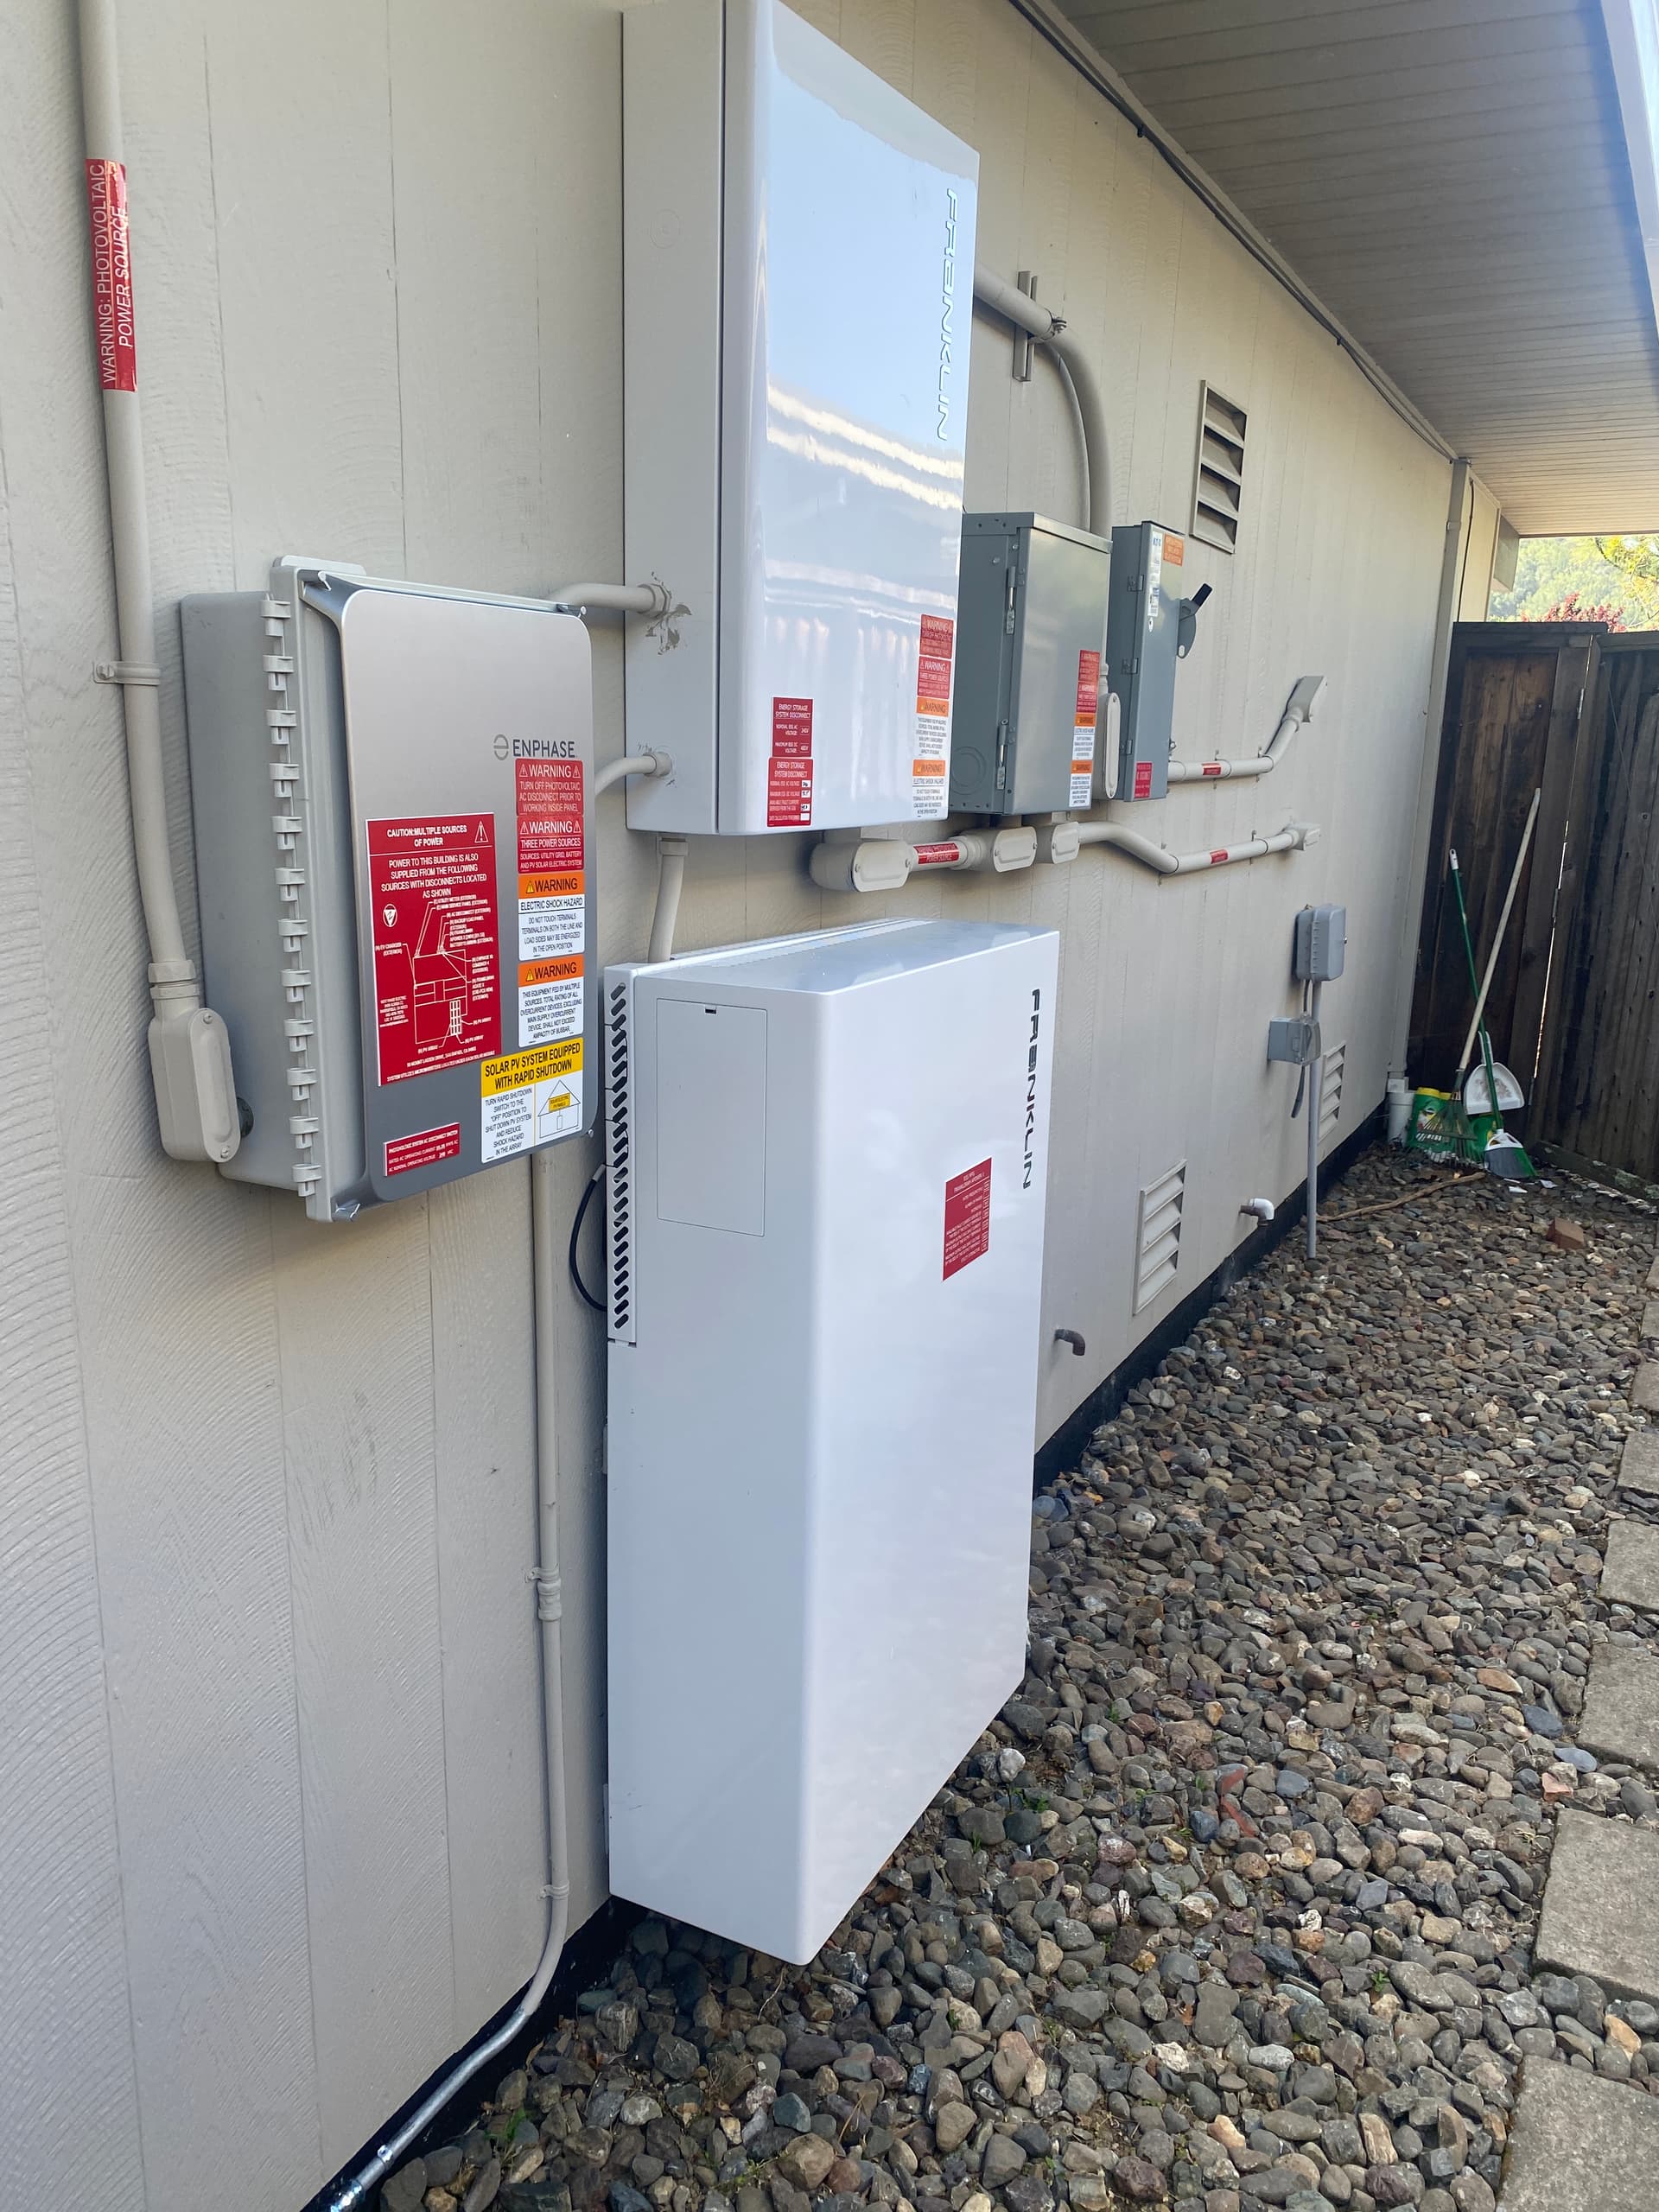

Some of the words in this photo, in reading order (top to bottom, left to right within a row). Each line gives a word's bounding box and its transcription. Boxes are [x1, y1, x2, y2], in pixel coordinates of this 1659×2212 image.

[89, 164, 111, 294] PHOTOVOLTAIC
[111, 205, 128, 278] SOURCE
[115, 283, 133, 347] POWER
[937, 188, 958, 442] FRANKLIN
[98, 299, 116, 383] WARNING:
[925, 661, 945, 671] WARNING
[925, 702, 945, 713] WARNING
[513, 739, 576, 759] ENPHASE
[529, 764, 571, 778] WARNING
[922, 762, 942, 772] WARNING
[519, 781, 534, 790] TURN
[442, 825, 467, 834] SOURCES
[530, 821, 572, 834] WARNING
[423, 837, 443, 846] POWER
[521, 840, 537, 849] THREE
[539, 839, 556, 848] POWER
[557, 838, 581, 847] SOURCES
[389, 859, 410, 868] POWER
[412, 858, 419, 867] TO
[421, 857, 432, 866] THIS
[434, 855, 457, 864] BUILDING
[465, 853, 478, 861] ALSO
[391, 869, 418, 880] SUPPLIED
[419, 868, 435, 877] FROM
[436, 867, 446, 875] THE
[448, 864, 478, 874] FOLLOWING
[381, 881, 409, 892] SOURCES
[410, 880, 424, 889] WITH
[426, 876, 462, 887] DISCONNECTS
[463, 874, 486, 883] LOCATED
[535, 878, 577, 892] WARNING
[423, 890, 429, 899] AS
[431, 888, 451, 898] SHOWN
[521, 900, 544, 911] ELECTRIC
[546, 899, 563, 909] SHOCK
[564, 897, 582, 907] HAZARD
[557, 913, 575, 922] TERMINALS
[522, 925, 543, 935] TERMINALS
[561, 931, 580, 940] ENERGIZED
[535, 962, 576, 979] WARNING
[531, 987, 551, 996] EQUIPMENT
[564, 982, 580, 992] MULTIPLE
[520, 1005, 546, 1016] OVERCURRENT
[563, 999, 582, 1009] EXCLUDING
[527, 1014, 536, 1023] MAIN
[537, 1013, 550, 1021] SUPPLY
[551, 1008, 575, 1019] OVERCURRENT
[543, 1020, 553, 1029] SHALL
[562, 1017, 575, 1026] EXCEED
[533, 1029, 550, 1039] AMPACITY
[486, 1060, 509, 1077] SOLAR
[512, 1058, 520, 1071] PV
[522, 1051, 548, 1068] SYSTEM
[550, 1042, 580, 1061] EQUIPPED
[495, 1074, 512, 1090] WITH
[515, 1069, 534, 1084] RAPID
[537, 1058, 572, 1079] SHUTDOWN
[1022, 988, 1040, 1191] FRANKLIN
[486, 1097, 497, 1106] TURN
[498, 1094, 509, 1103] RAPID
[510, 1088, 532, 1099] SHUTDOWN
[493, 1103, 509, 1113] SWITCH
[502, 1109, 521, 1119] POSITION
[486, 1123, 497, 1133] SHUT
[498, 1120, 509, 1129] DOWN
[517, 1113, 531, 1123] SYSTEM
[505, 1125, 522, 1135] REDUCE
[493, 1138, 507, 1147] SHOCK
[508, 1133, 524, 1143] HAZARD
[507, 1142, 522, 1153] ARRAY
